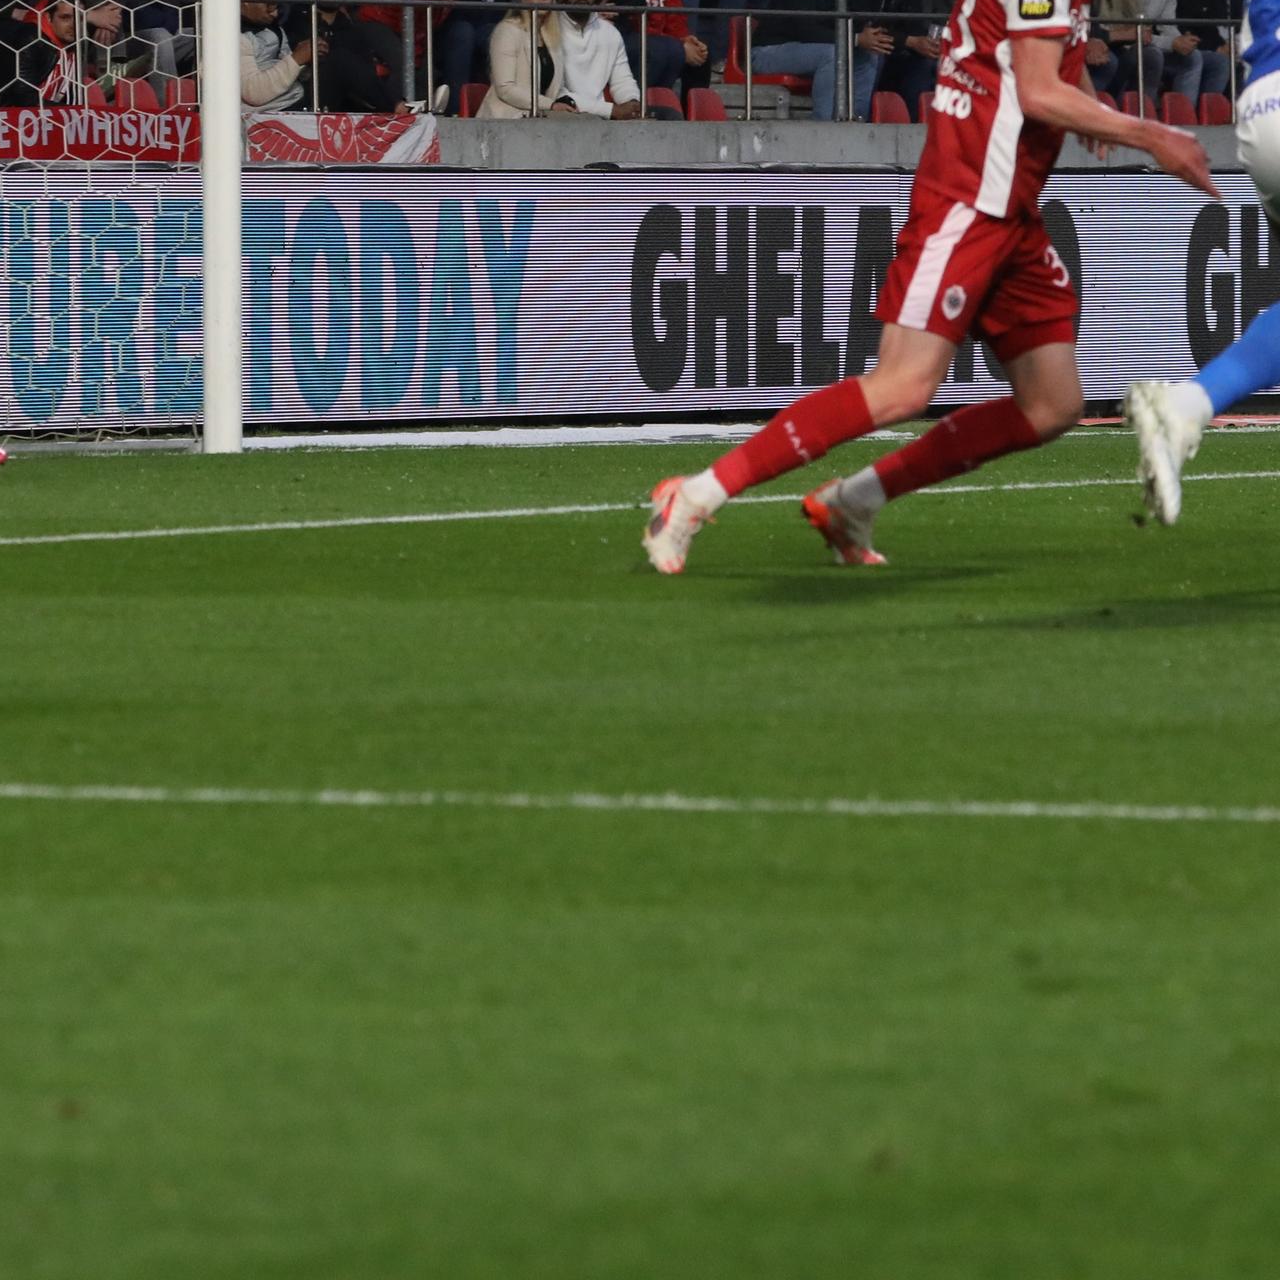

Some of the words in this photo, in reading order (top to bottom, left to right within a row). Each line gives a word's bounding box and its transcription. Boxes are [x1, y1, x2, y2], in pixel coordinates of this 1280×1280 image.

[18, 108, 55, 146] OF
[61, 106, 192, 152] WHISKEY
[242, 196, 536, 414] TODAY
